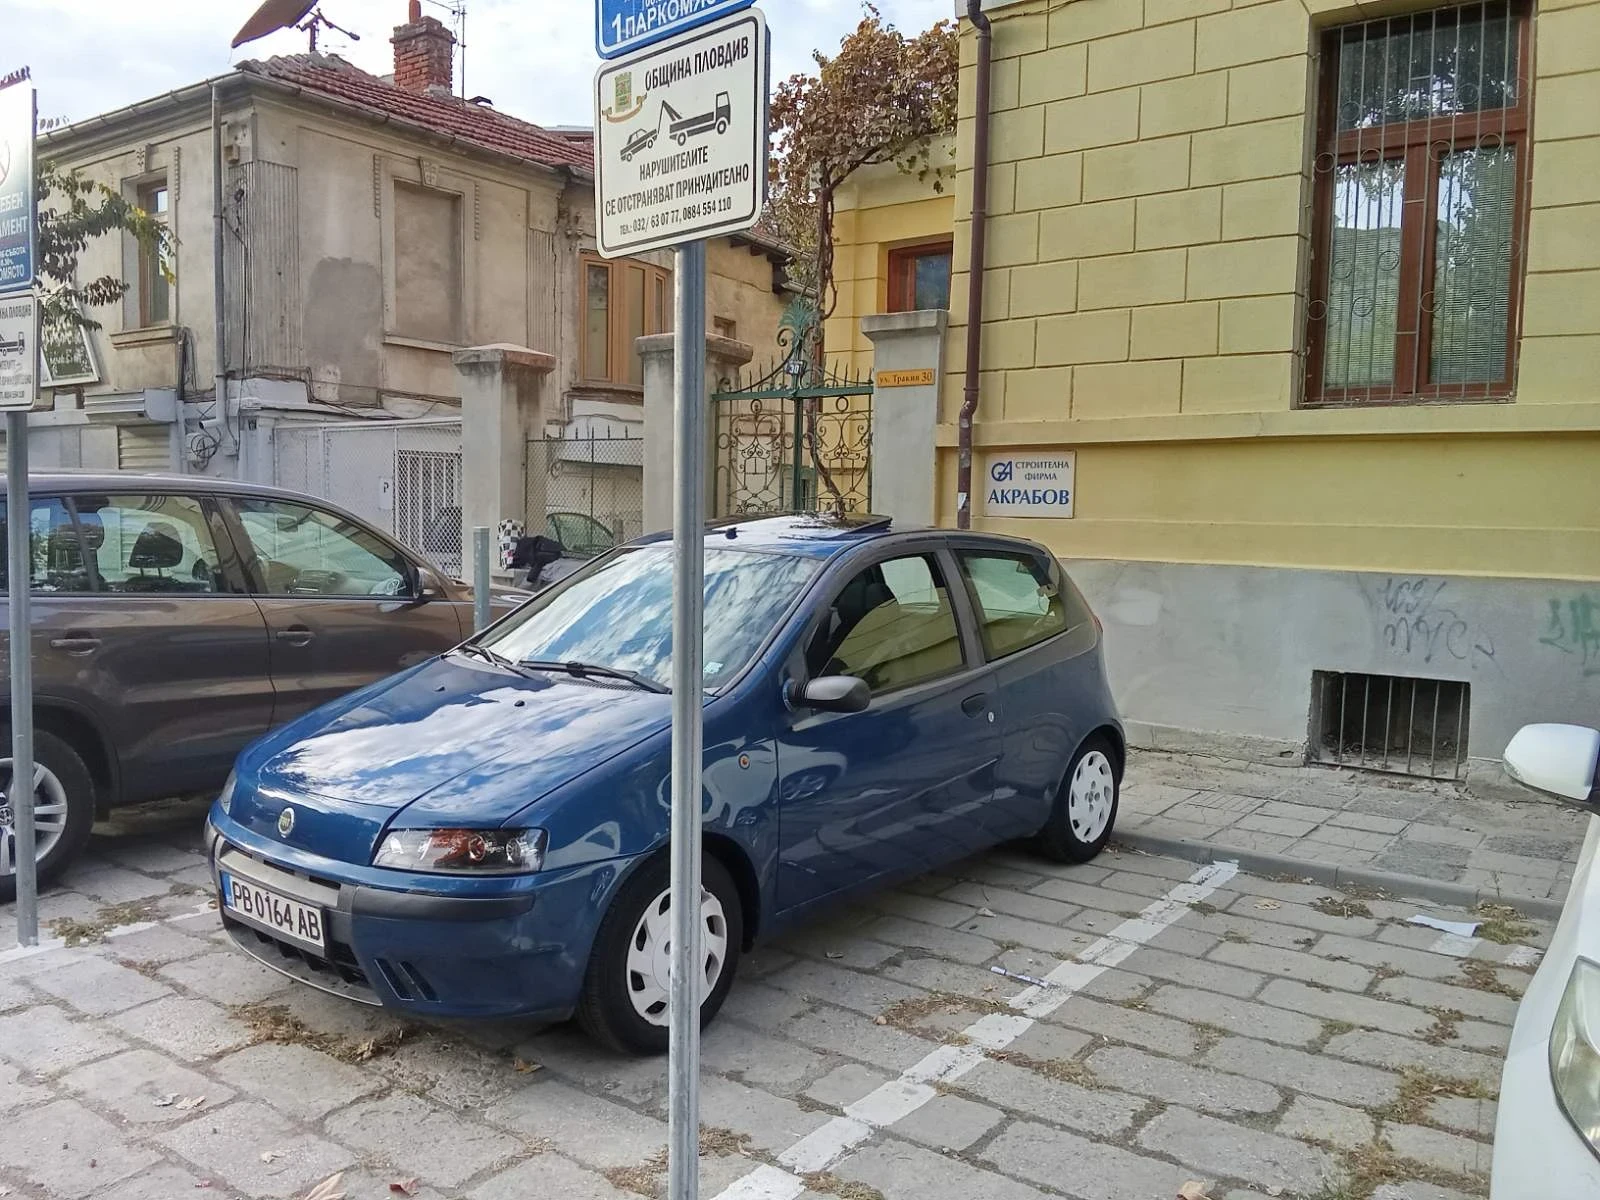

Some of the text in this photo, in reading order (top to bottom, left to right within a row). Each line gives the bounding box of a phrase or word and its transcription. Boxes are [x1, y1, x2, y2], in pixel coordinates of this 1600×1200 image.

[645, 36, 749, 91] ОБЩИНА ПЛОВДИВ
[639, 145, 709, 182] НАРУШИТЕЛИТЕ
[605, 163, 749, 217] СЕ ОТСТРАНЯВАТ ПРИНУДИТЕЛНО
[632, 216, 649, 232] 032/
[651, 213, 660, 228] 63
[661, 212, 670, 226] 07
[682, 204, 701, 220] 0884
[702, 200, 717, 216] 554
[718, 196, 732, 212] 110
[921, 371, 933, 382] 30
[1015, 461, 1070, 470] СТРОИТЕЛНА
[1024, 472, 1058, 481] ФИРМА
[987, 488, 1070, 505] АКРАБОВ
[255, 891, 294, 932] 0164
[298, 907, 321, 941] AB
